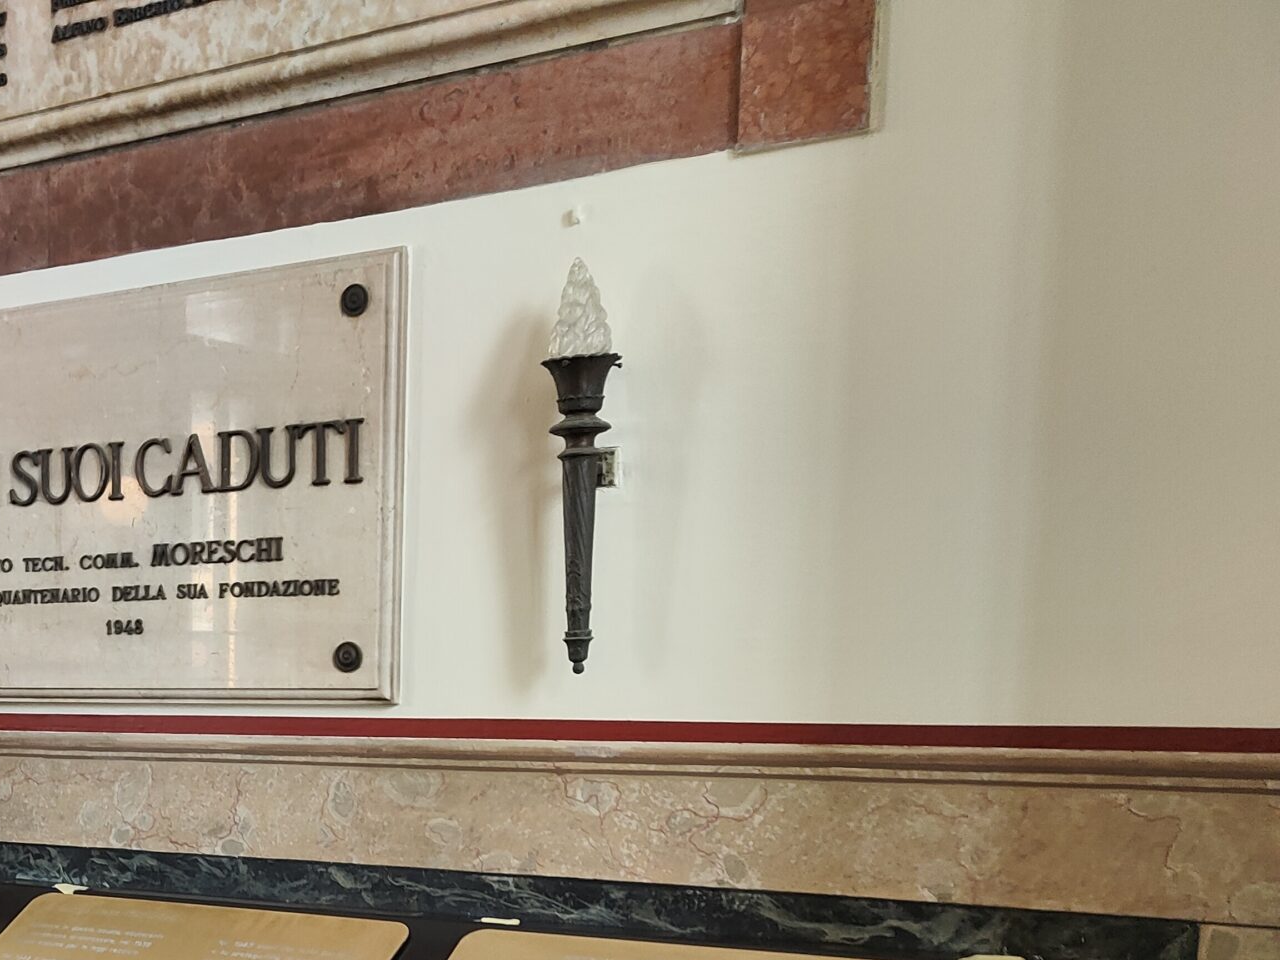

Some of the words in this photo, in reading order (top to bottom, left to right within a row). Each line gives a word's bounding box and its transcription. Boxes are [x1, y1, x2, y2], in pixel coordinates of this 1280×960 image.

[9, 441, 125, 507] SUOI
[135, 417, 365, 499] CADUTI
[79, 552, 139, 570] COMM.
[150, 537, 284, 567] MORESCHI
[112, 584, 166, 602] DELLA
[176, 583, 208, 600] SUA
[219, 578, 340, 599] FONDAZIONE
[106, 619, 144, 636] 1948
